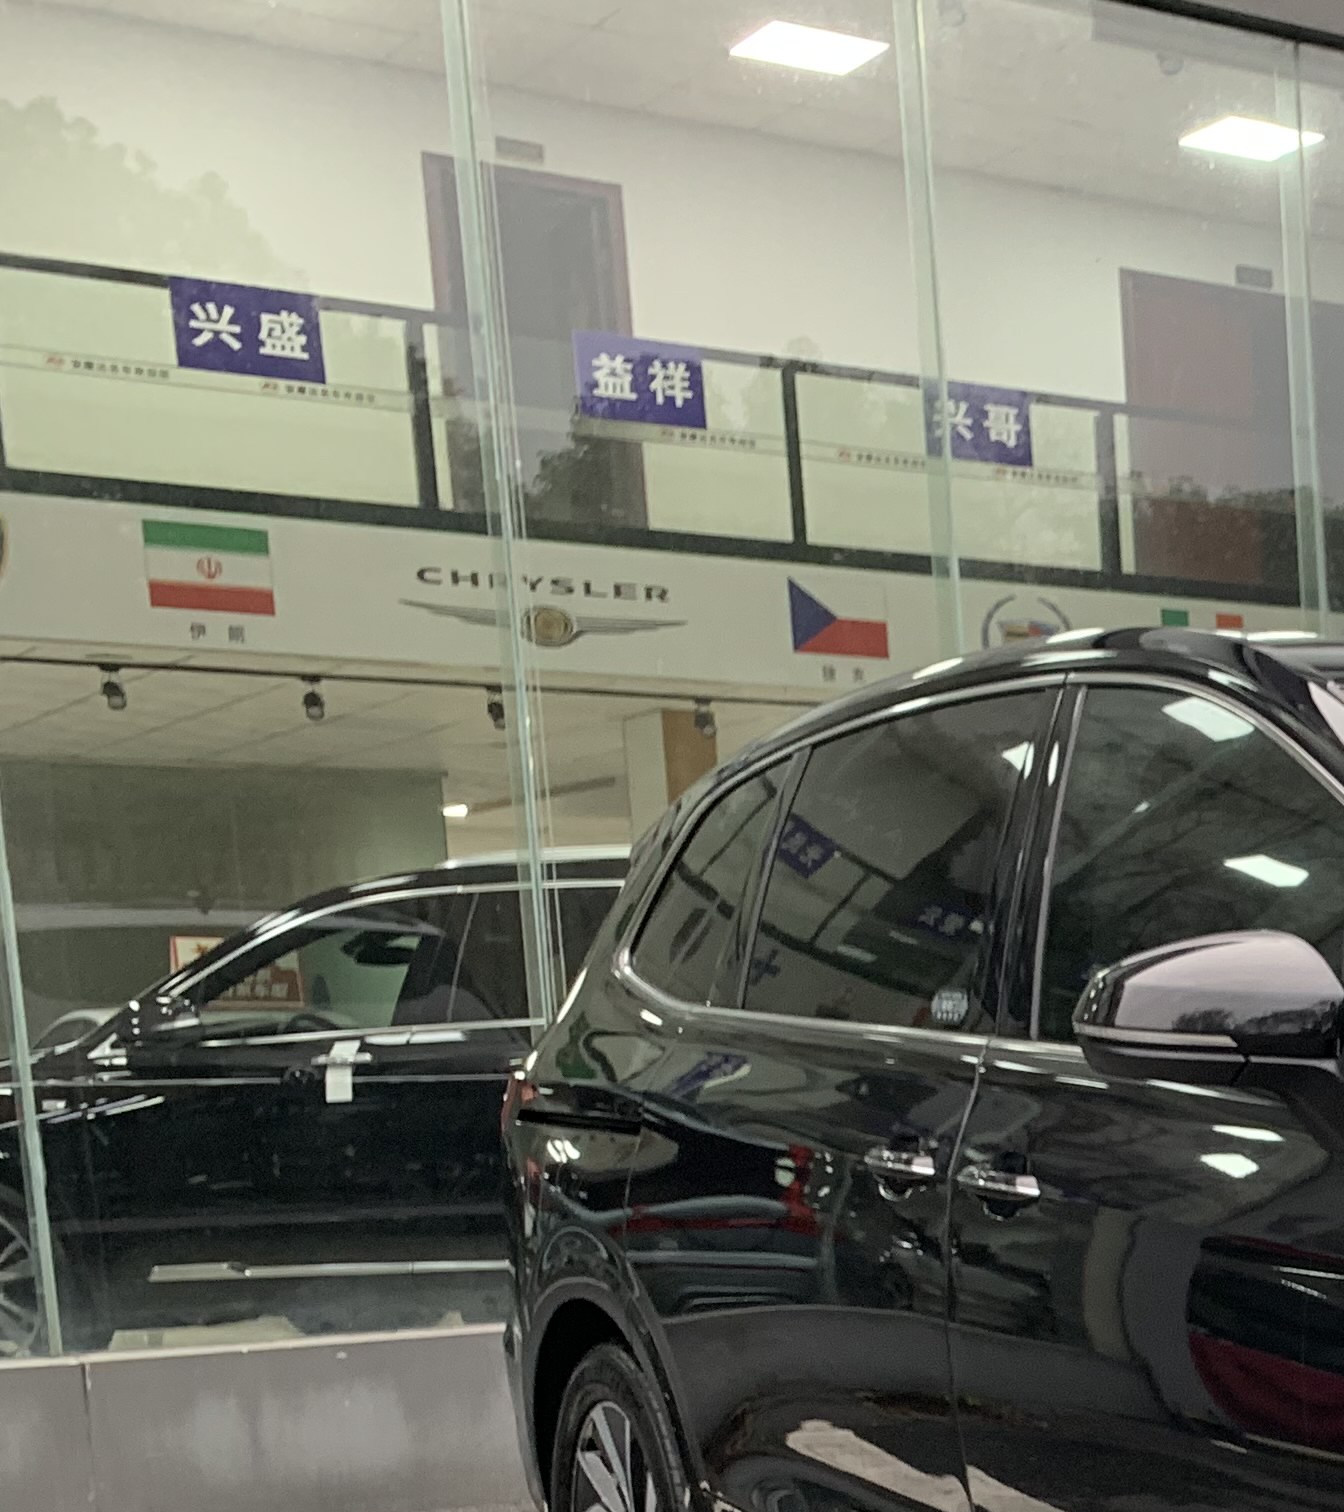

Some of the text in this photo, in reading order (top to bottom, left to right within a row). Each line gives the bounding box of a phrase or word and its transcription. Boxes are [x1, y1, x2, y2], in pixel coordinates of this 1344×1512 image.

[188, 301, 310, 361] 兴盛
[591, 351, 695, 409] 益祥
[933, 399, 1022, 448] 兴哥
